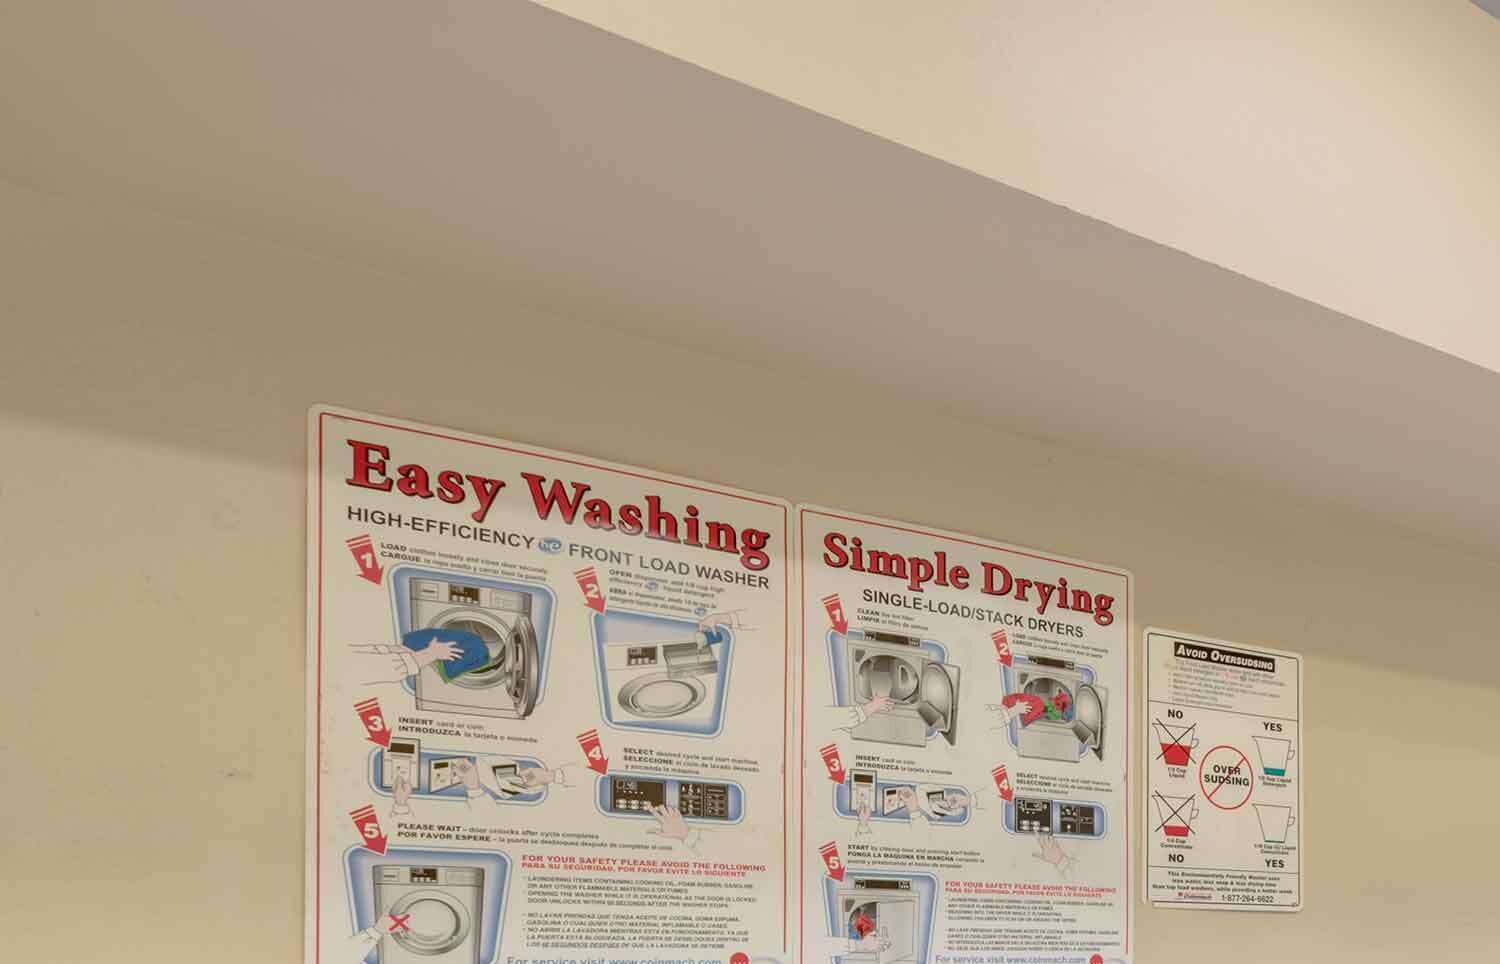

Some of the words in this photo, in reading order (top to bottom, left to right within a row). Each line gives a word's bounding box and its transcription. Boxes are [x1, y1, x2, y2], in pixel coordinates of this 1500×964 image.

[346, 439, 505, 522] Easy
[520, 472, 770, 570] Washing
[347, 505, 535, 550] HIGH-EFFICIENCY
[569, 543, 633, 567] FRONT
[639, 555, 690, 576] LOAD
[695, 564, 769, 590] WASHER
[380, 542, 407, 552] LOAD
[360, 551, 372, 568] 1
[380, 551, 421, 563] CARGUE
[609, 568, 632, 579] OPEN
[823, 531, 970, 593] Simple
[980, 560, 1115, 626] Drying
[585, 582, 599, 599] 2
[831, 608, 841, 621] 1
[862, 588, 1024, 629] SINGLE-LOAD/STACK
[1028, 616, 1084, 638] DRYERS
[998, 643, 1009, 656] 2
[1175, 644, 1208, 660] AVOID
[1210, 650, 1274, 671] OVERSUDSING
[1167, 708, 1184, 720] NO
[368, 715, 382, 732] 3
[398, 716, 434, 727] INSERT
[1263, 721, 1283, 734] YES
[398, 725, 462, 737] INTRODUZCA
[588, 745, 602, 761] 4
[623, 747, 654, 756] SELECT
[623, 755, 673, 765] SELECCIONE
[829, 758, 842, 773] 3
[1212, 764, 1241, 776] OVER
[1203, 774, 1250, 787] SUDSING
[363, 822, 379, 839] 5
[397, 822, 435, 832] PLEASE
[437, 824, 462, 833] WAIT
[397, 831, 418, 839] POR
[420, 831, 452, 841] FAVOR
[455, 833, 491, 842] ESPERE
[521, 854, 543, 863] FOR
[547, 855, 576, 864] YOUR
[579, 856, 617, 866] SAFETY
[620, 857, 657, 868] PLEASE
[661, 860, 689, 869] AVOID
[692, 861, 712, 870] THE
[713, 862, 767, 873] FOLLOWING
[828, 856, 840, 870] 5
[1168, 853, 1185, 864] NO
[1264, 858, 1285, 869] YES
[521, 862, 546, 870] PARA
[548, 862, 560, 870] SU
[618, 865, 635, 873] POR
[637, 866, 665, 875] FAVOR
[963, 881, 984, 889] YOUR
[985, 882, 1013, 890] SAFETY
[935, 955, 951, 964] For
[953, 955, 985, 964] service
[987, 955, 1005, 964] visit
[1007, 955, 1086, 964] www.coinmach.com
